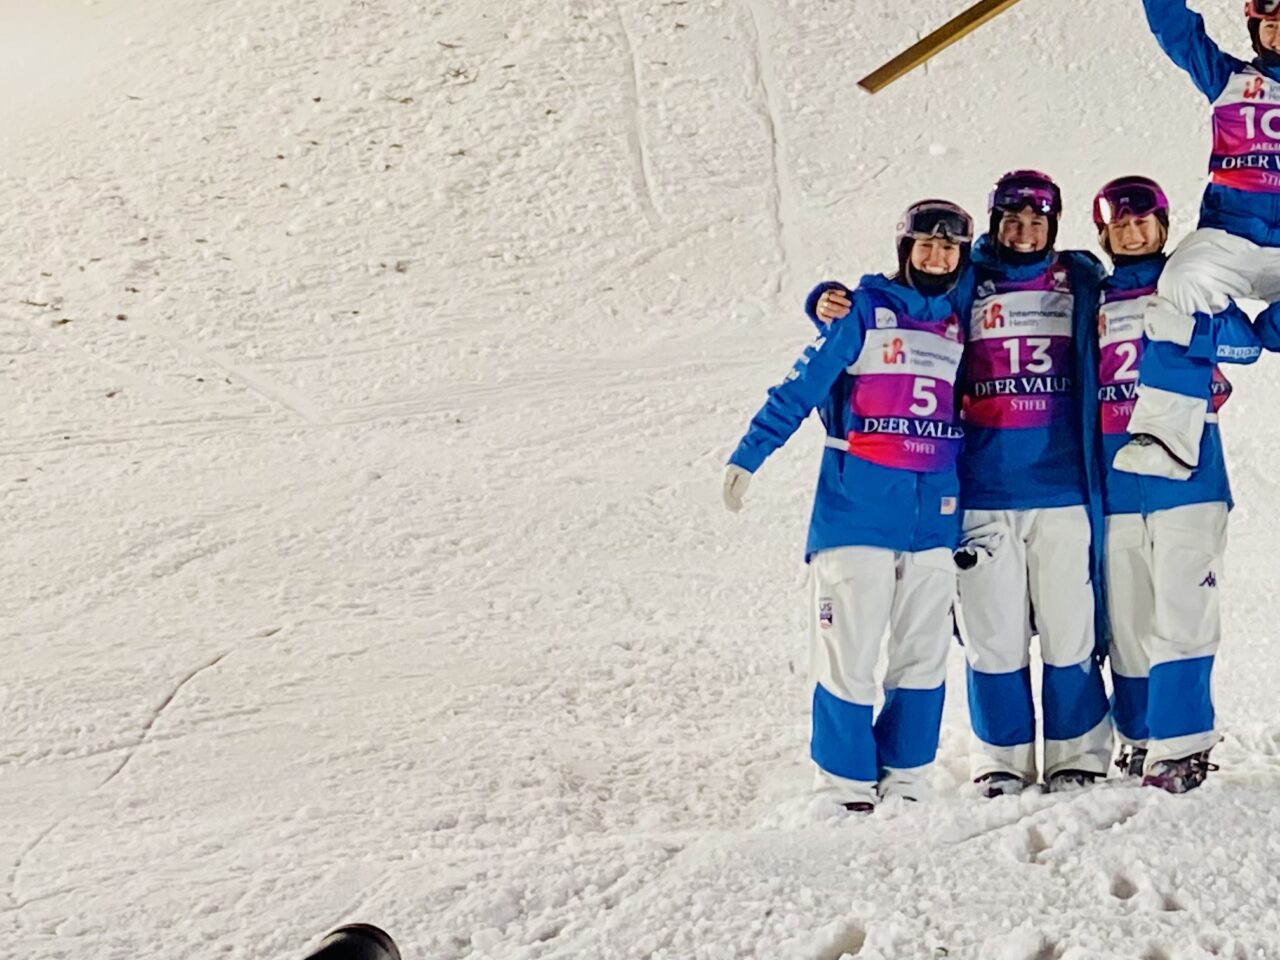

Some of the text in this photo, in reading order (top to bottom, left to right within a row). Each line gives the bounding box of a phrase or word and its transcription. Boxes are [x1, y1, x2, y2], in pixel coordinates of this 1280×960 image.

[1221, 155, 1270, 170] DEER
[1002, 337, 1053, 375] 13
[975, 378, 1018, 396] DEER
[1097, 385, 1118, 402] ER
[909, 377, 938, 417] 5
[863, 417, 910, 435] DEER
